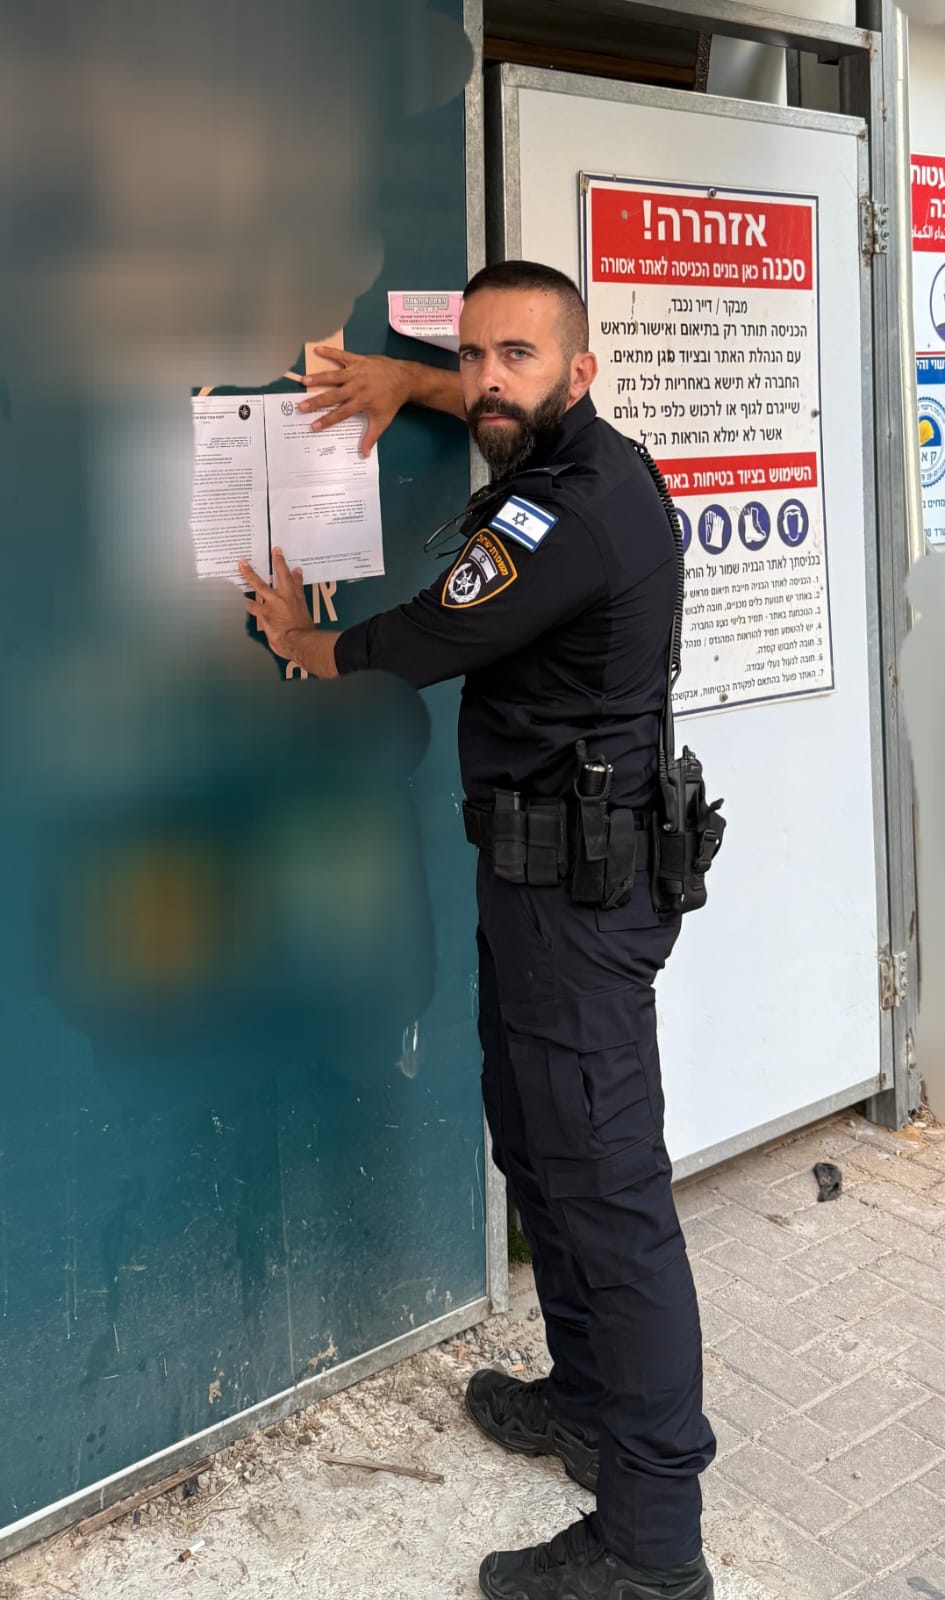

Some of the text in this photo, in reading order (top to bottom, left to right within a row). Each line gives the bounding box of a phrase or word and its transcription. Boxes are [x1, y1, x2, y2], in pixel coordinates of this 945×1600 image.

[642, 199, 767, 247] אזהרה!
[600, 256, 805, 283] סכנה כאן בונים הכניסה לאתר אסורה
[668, 297, 748, 317] מבקר / דייר נכבד,
[600, 321, 807, 339] הכניסה תותר רק בתיאום ואישור מראש
[610, 347, 801, 367] עם הנהלת האתר ובציוד מגן מתאים.
[617, 373, 799, 394] החברה לא תישא באחריות לכל נזק
[614, 399, 800, 419] שייגרם לגוף או לרכוש כלפי כל גורם
[671, 430, 710, 445] הוראות
[713, 427, 739, 442] ימלא
[743, 425, 756, 441] לא
[760, 427, 783, 441] אשר
[693, 471, 735, 488] בטיחות
[737, 469, 766, 485] בציוד
[769, 465, 811, 483] השימוש
[489, 546, 508, 576] משטרת
[742, 560, 764, 573] הבניה
[767, 556, 787, 568] לאתר
[790, 554, 820, 571] בכניסתך
[706, 564, 717, 577] על
[719, 563, 740, 576] שמור
[751, 581, 769, 590] הבניה
[770, 577, 787, 587] לאתר
[789, 576, 812, 586] הכניסה
[813, 576, 819, 584] 1.
[689, 588, 709, 598] מראש
[711, 585, 730, 595] תיאום
[731, 583, 749, 592] חייבת
[764, 596, 784, 605] תנועת
[795, 593, 812, 602] באתר
[814, 591, 820, 599] 2.
[748, 597, 763, 606] כלים
[684, 604, 705, 616] ללבוש
[706, 604, 723, 613] חובה
[748, 614, 764, 624] תמיד
[769, 611, 787, 620] באתר
[689, 619, 714, 631] החברה.
[781, 622, 804, 635] להשמע
[816, 623, 822, 631] 4.
[736, 630, 762, 642] להוראות
[763, 629, 779, 638] תמיד
[684, 636, 702, 649] מנהל
[778, 640, 798, 651] לחבוש
[799, 639, 815, 648] חובה
[767, 658, 780, 668] נעלי
[782, 655, 798, 666] לנעול
[799, 655, 816, 664] חובה
[744, 662, 765, 673] עבודה.
[757, 675, 780, 686] בהתאם
[782, 671, 797, 682] פועל
[799, 670, 816, 680] האתר
[732, 678, 755, 691] לפקודת
